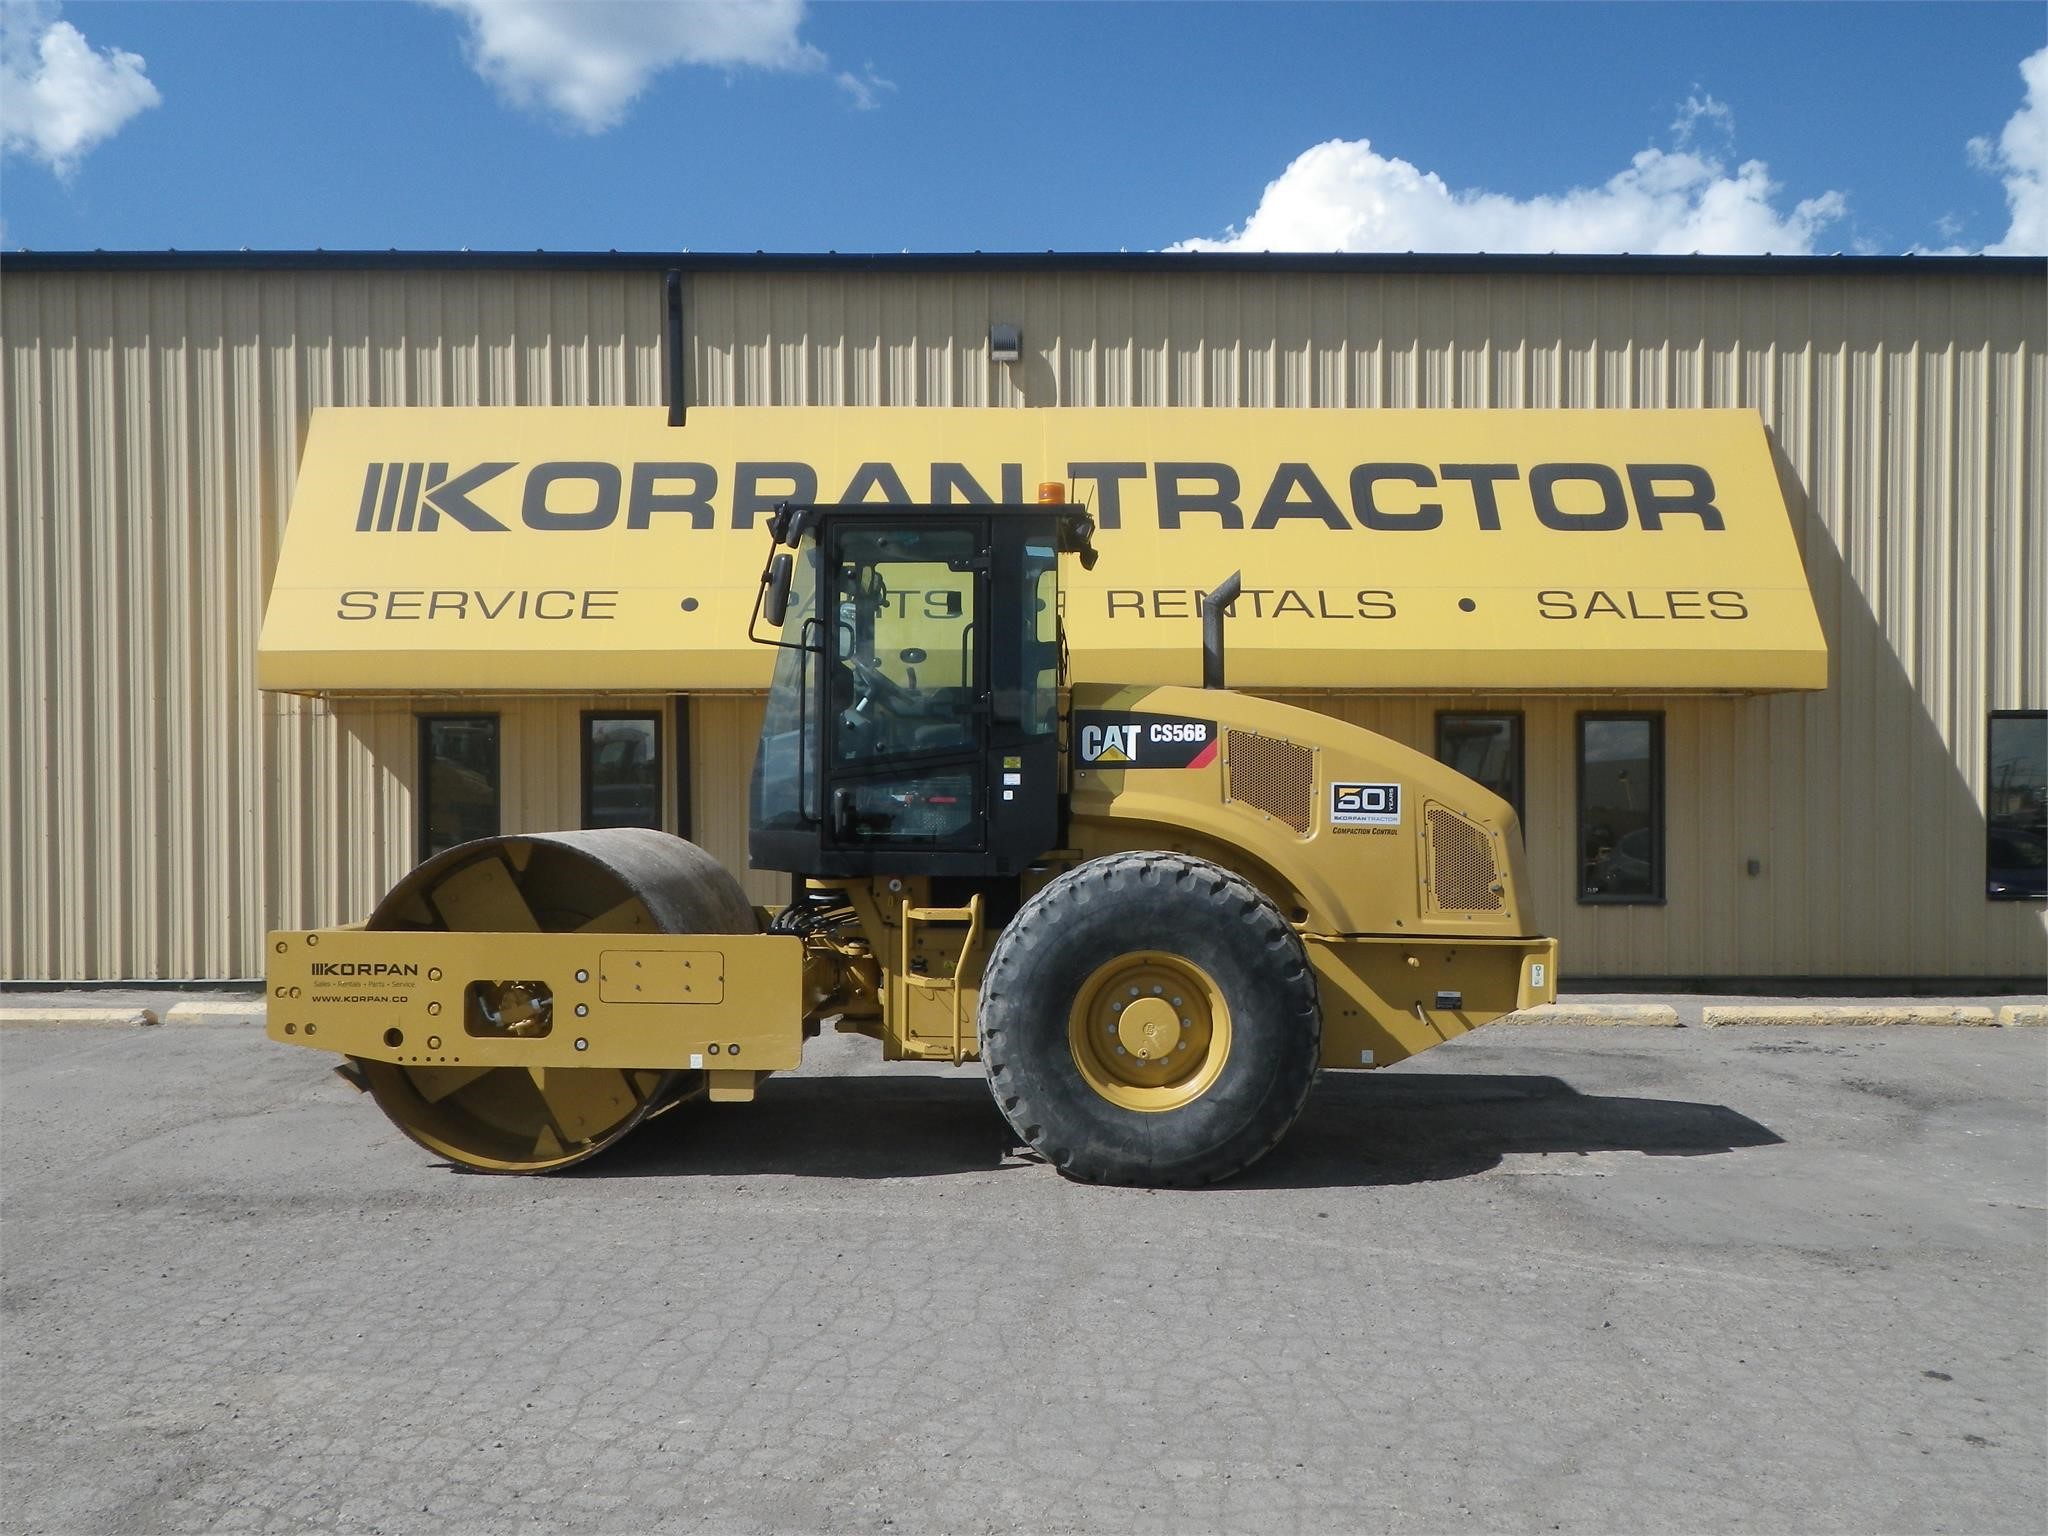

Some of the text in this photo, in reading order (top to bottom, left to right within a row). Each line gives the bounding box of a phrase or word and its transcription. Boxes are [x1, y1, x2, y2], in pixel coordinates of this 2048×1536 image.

[1067, 462, 1726, 532] TRACTOR
[337, 590, 619, 620] SERVICE
[1537, 590, 1749, 620] SALES
[1082, 724, 1206, 761] CAT CS56B
[1337, 788, 1386, 811] 50
[311, 963, 418, 976] KORPAN
